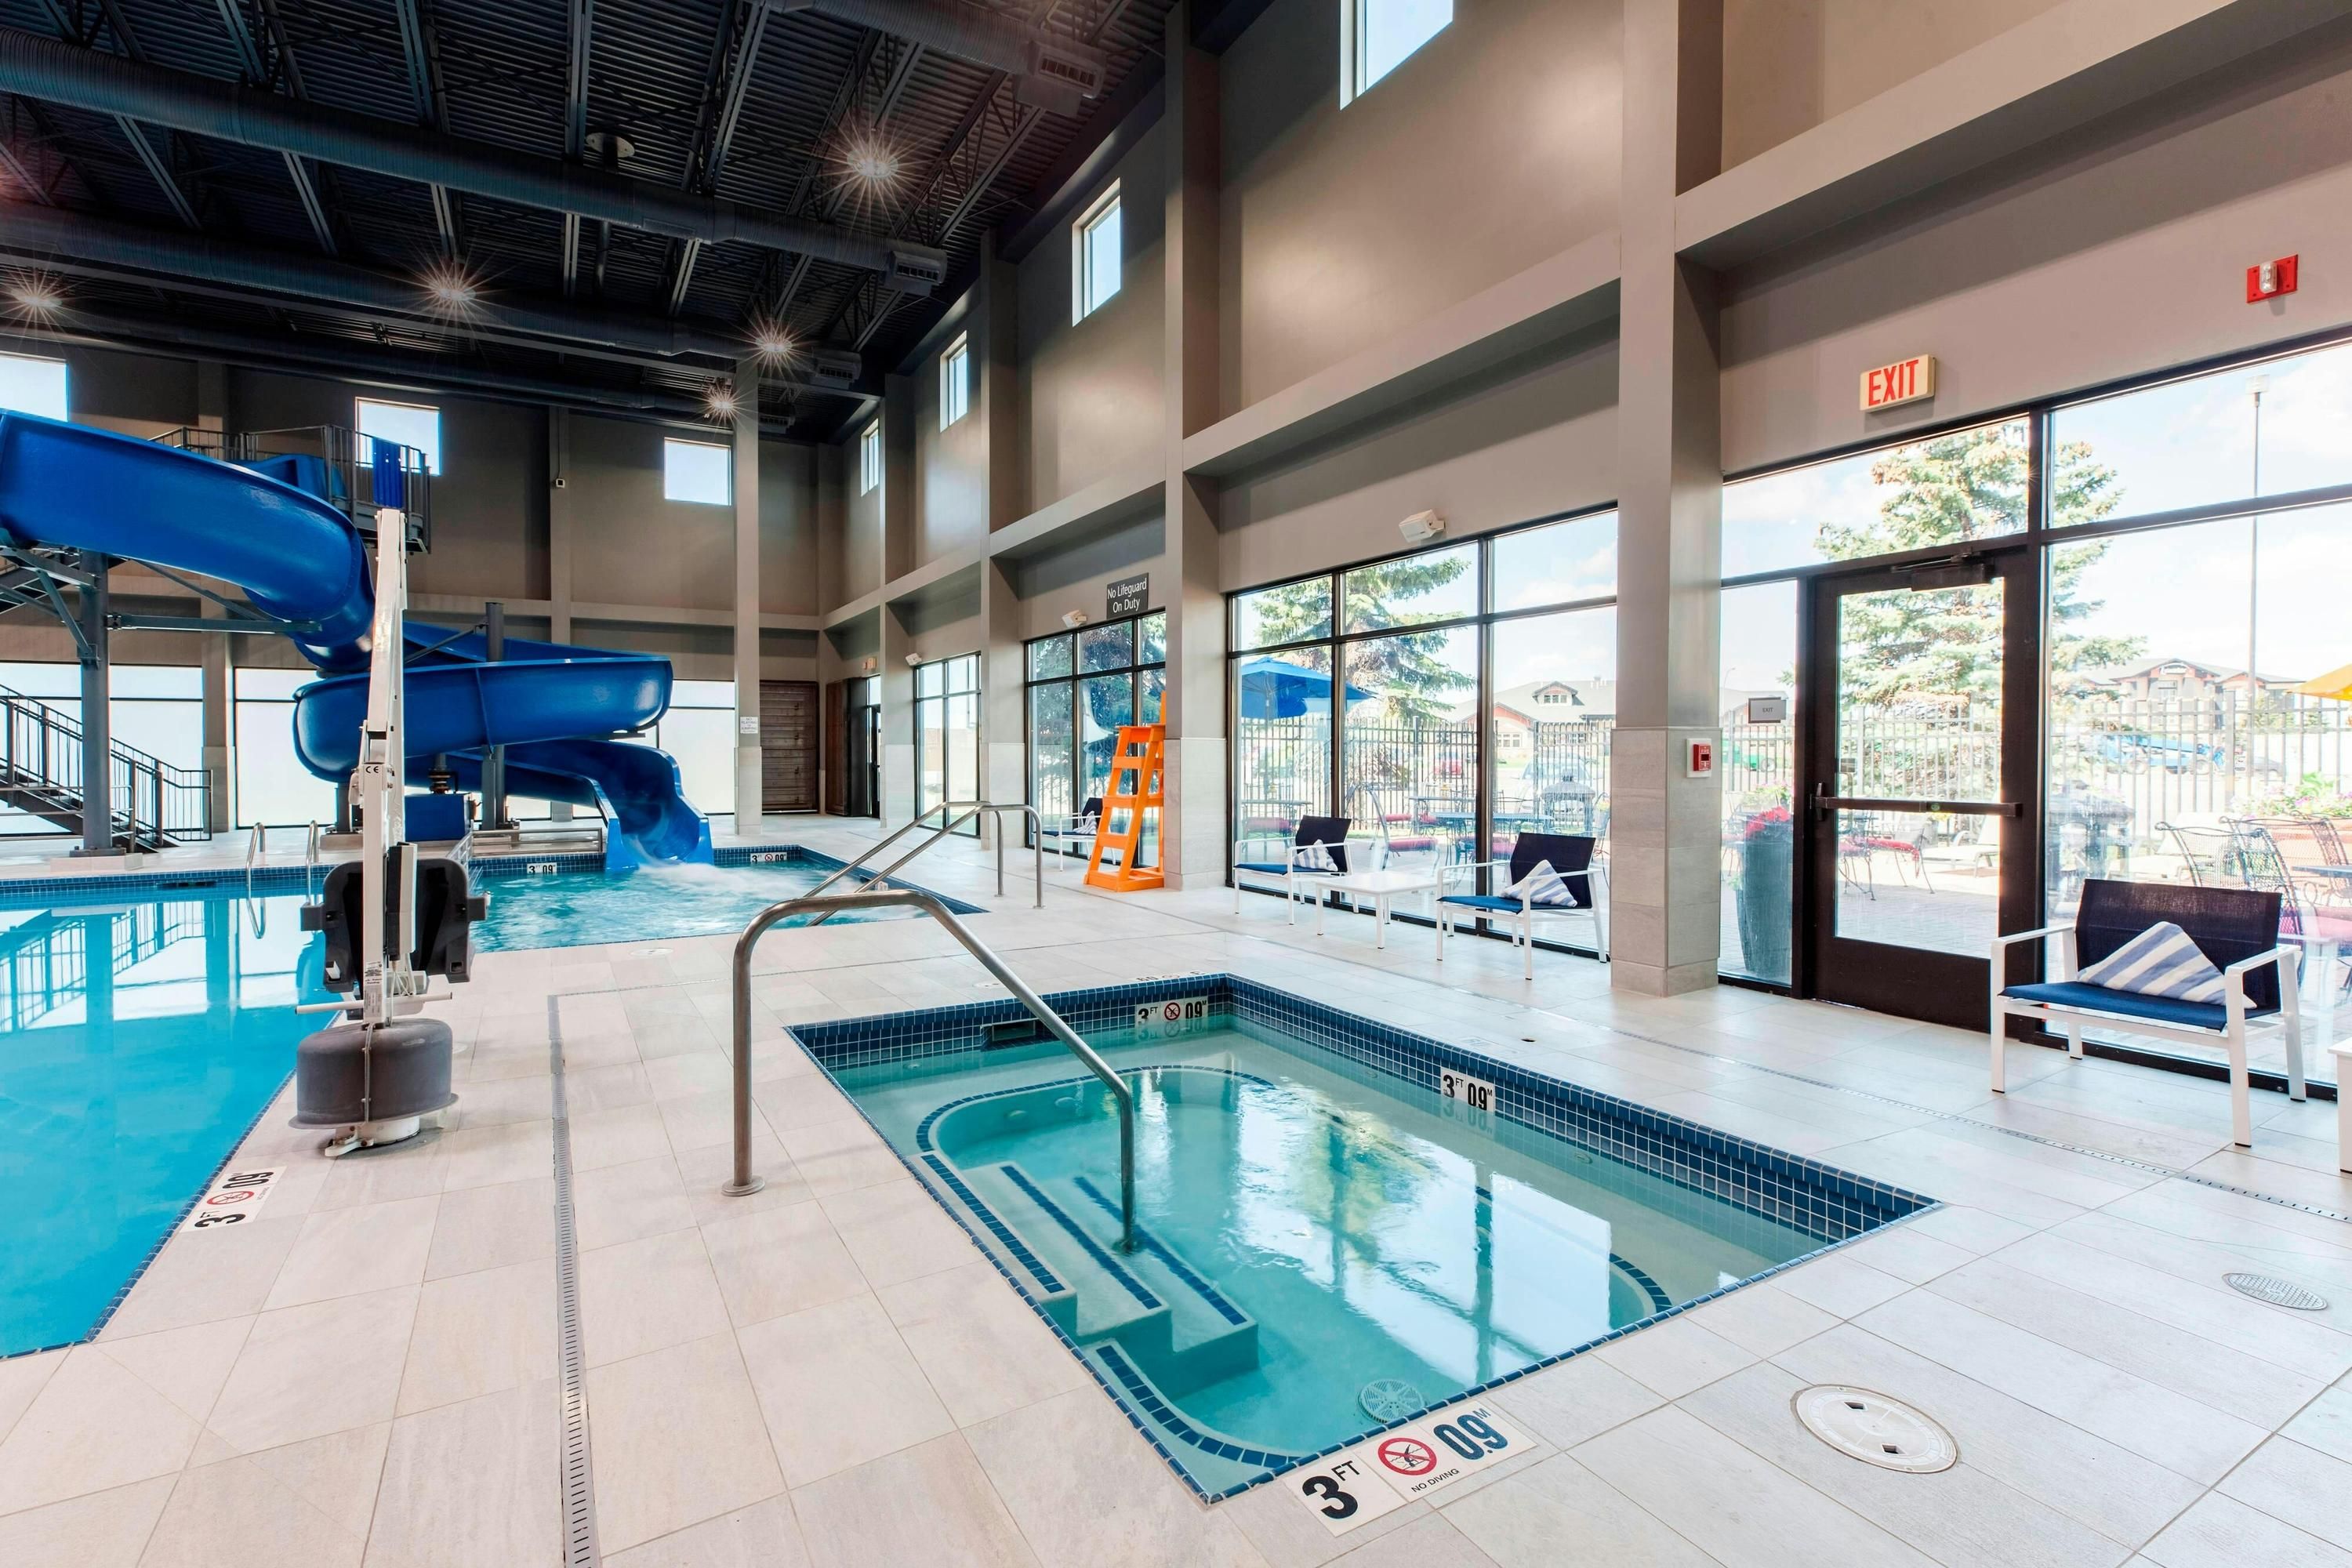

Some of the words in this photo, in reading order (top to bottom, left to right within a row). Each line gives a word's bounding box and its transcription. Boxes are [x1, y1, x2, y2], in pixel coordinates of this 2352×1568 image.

[1868, 359, 1919, 406] EXIT
[1107, 588, 1116, 600] No
[1117, 577, 1147, 597] Lifeguard
[1112, 602, 1122, 613] On
[1124, 598, 1141, 612] Duty
[1443, 1074, 1455, 1098] 3
[1455, 1077, 1465, 1088] FT
[1302, 1475, 1358, 1519] 3
[1331, 1461, 1360, 1481] FT
[1472, 1408, 1491, 1419] M
[1411, 1483, 1427, 1493] NO
[1427, 1468, 1460, 1486] DIVING
